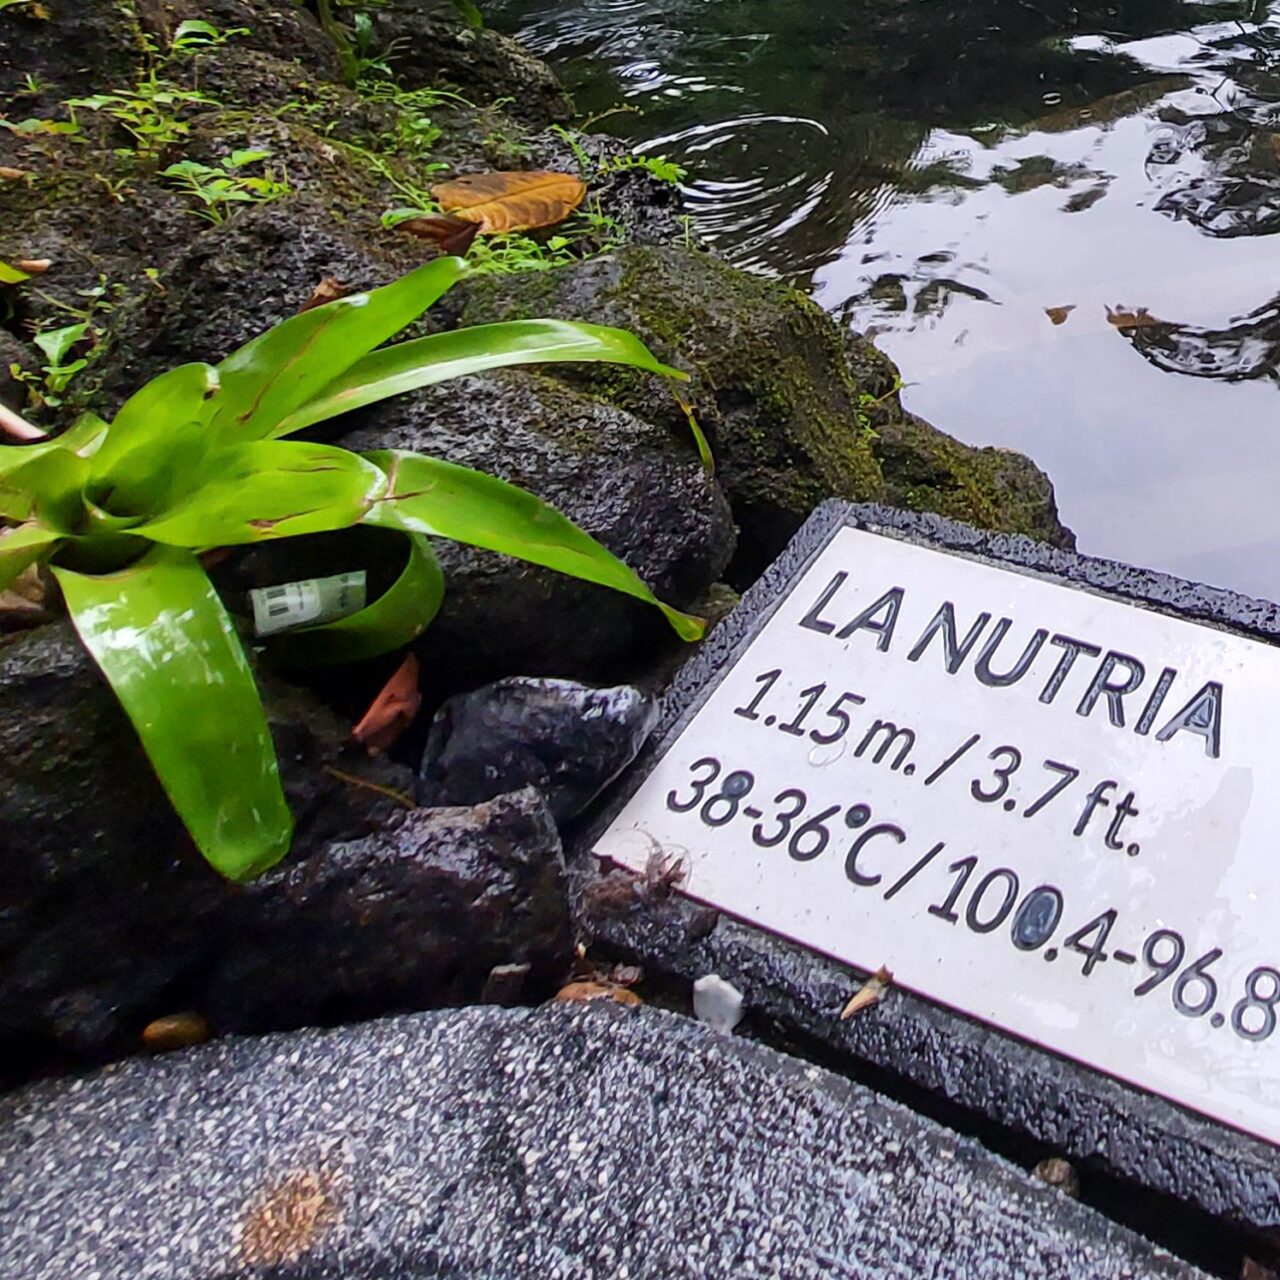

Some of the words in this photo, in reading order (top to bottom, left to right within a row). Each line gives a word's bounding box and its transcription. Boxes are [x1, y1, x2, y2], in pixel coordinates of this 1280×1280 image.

[798, 570, 905, 653] LA
[906, 601, 1224, 759] NUTRIA
[732, 667, 866, 746] 1.15
[970, 745, 1080, 819] 3.7
[1072, 780, 1141, 857] ft.
